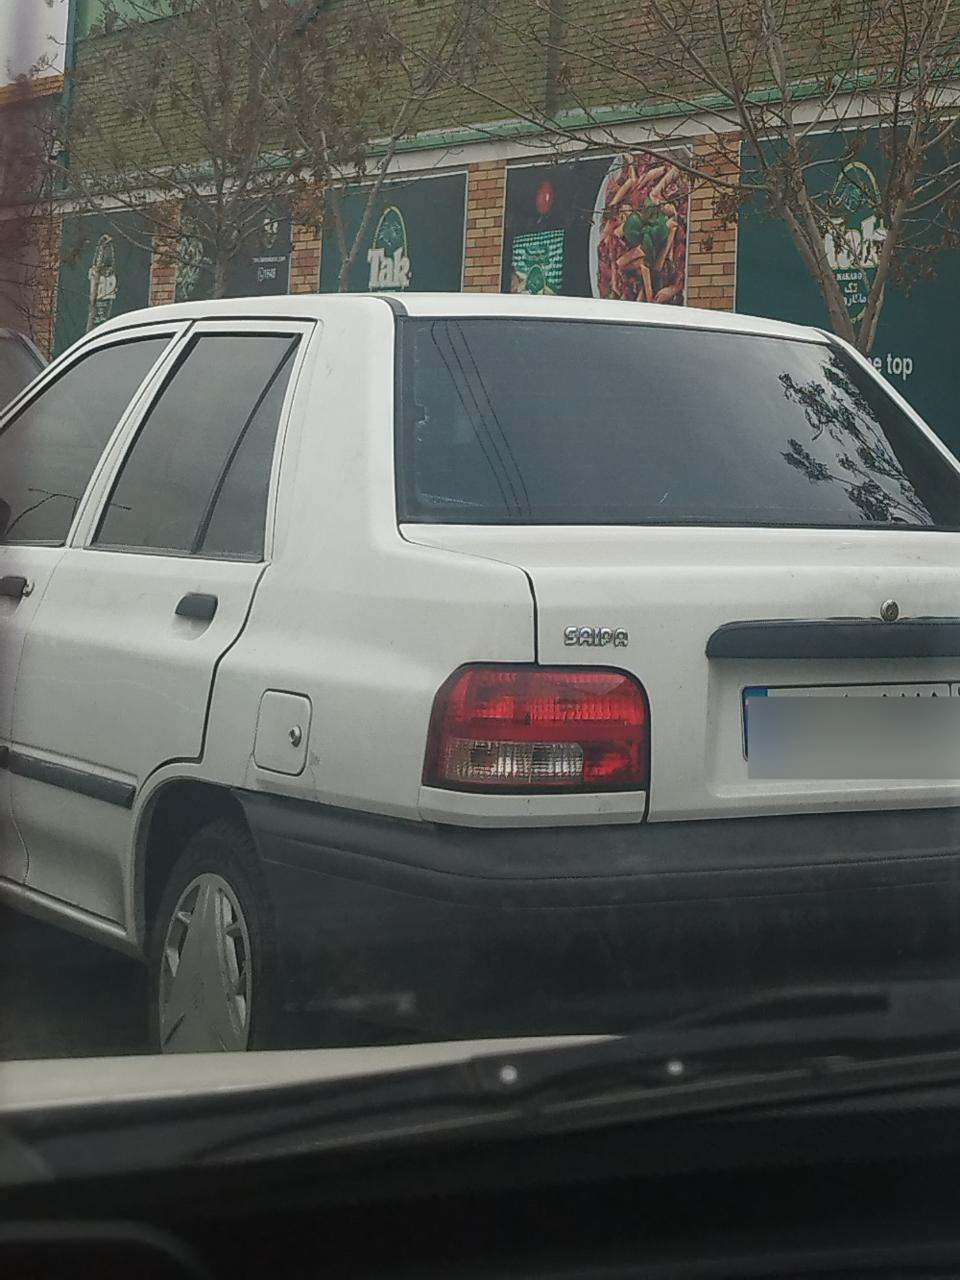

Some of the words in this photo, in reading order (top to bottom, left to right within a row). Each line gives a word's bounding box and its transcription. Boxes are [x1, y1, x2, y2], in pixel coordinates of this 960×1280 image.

[368, 247, 410, 288] Tak
[887, 353, 913, 380] top
[564, 627, 628, 647] SAIPA
